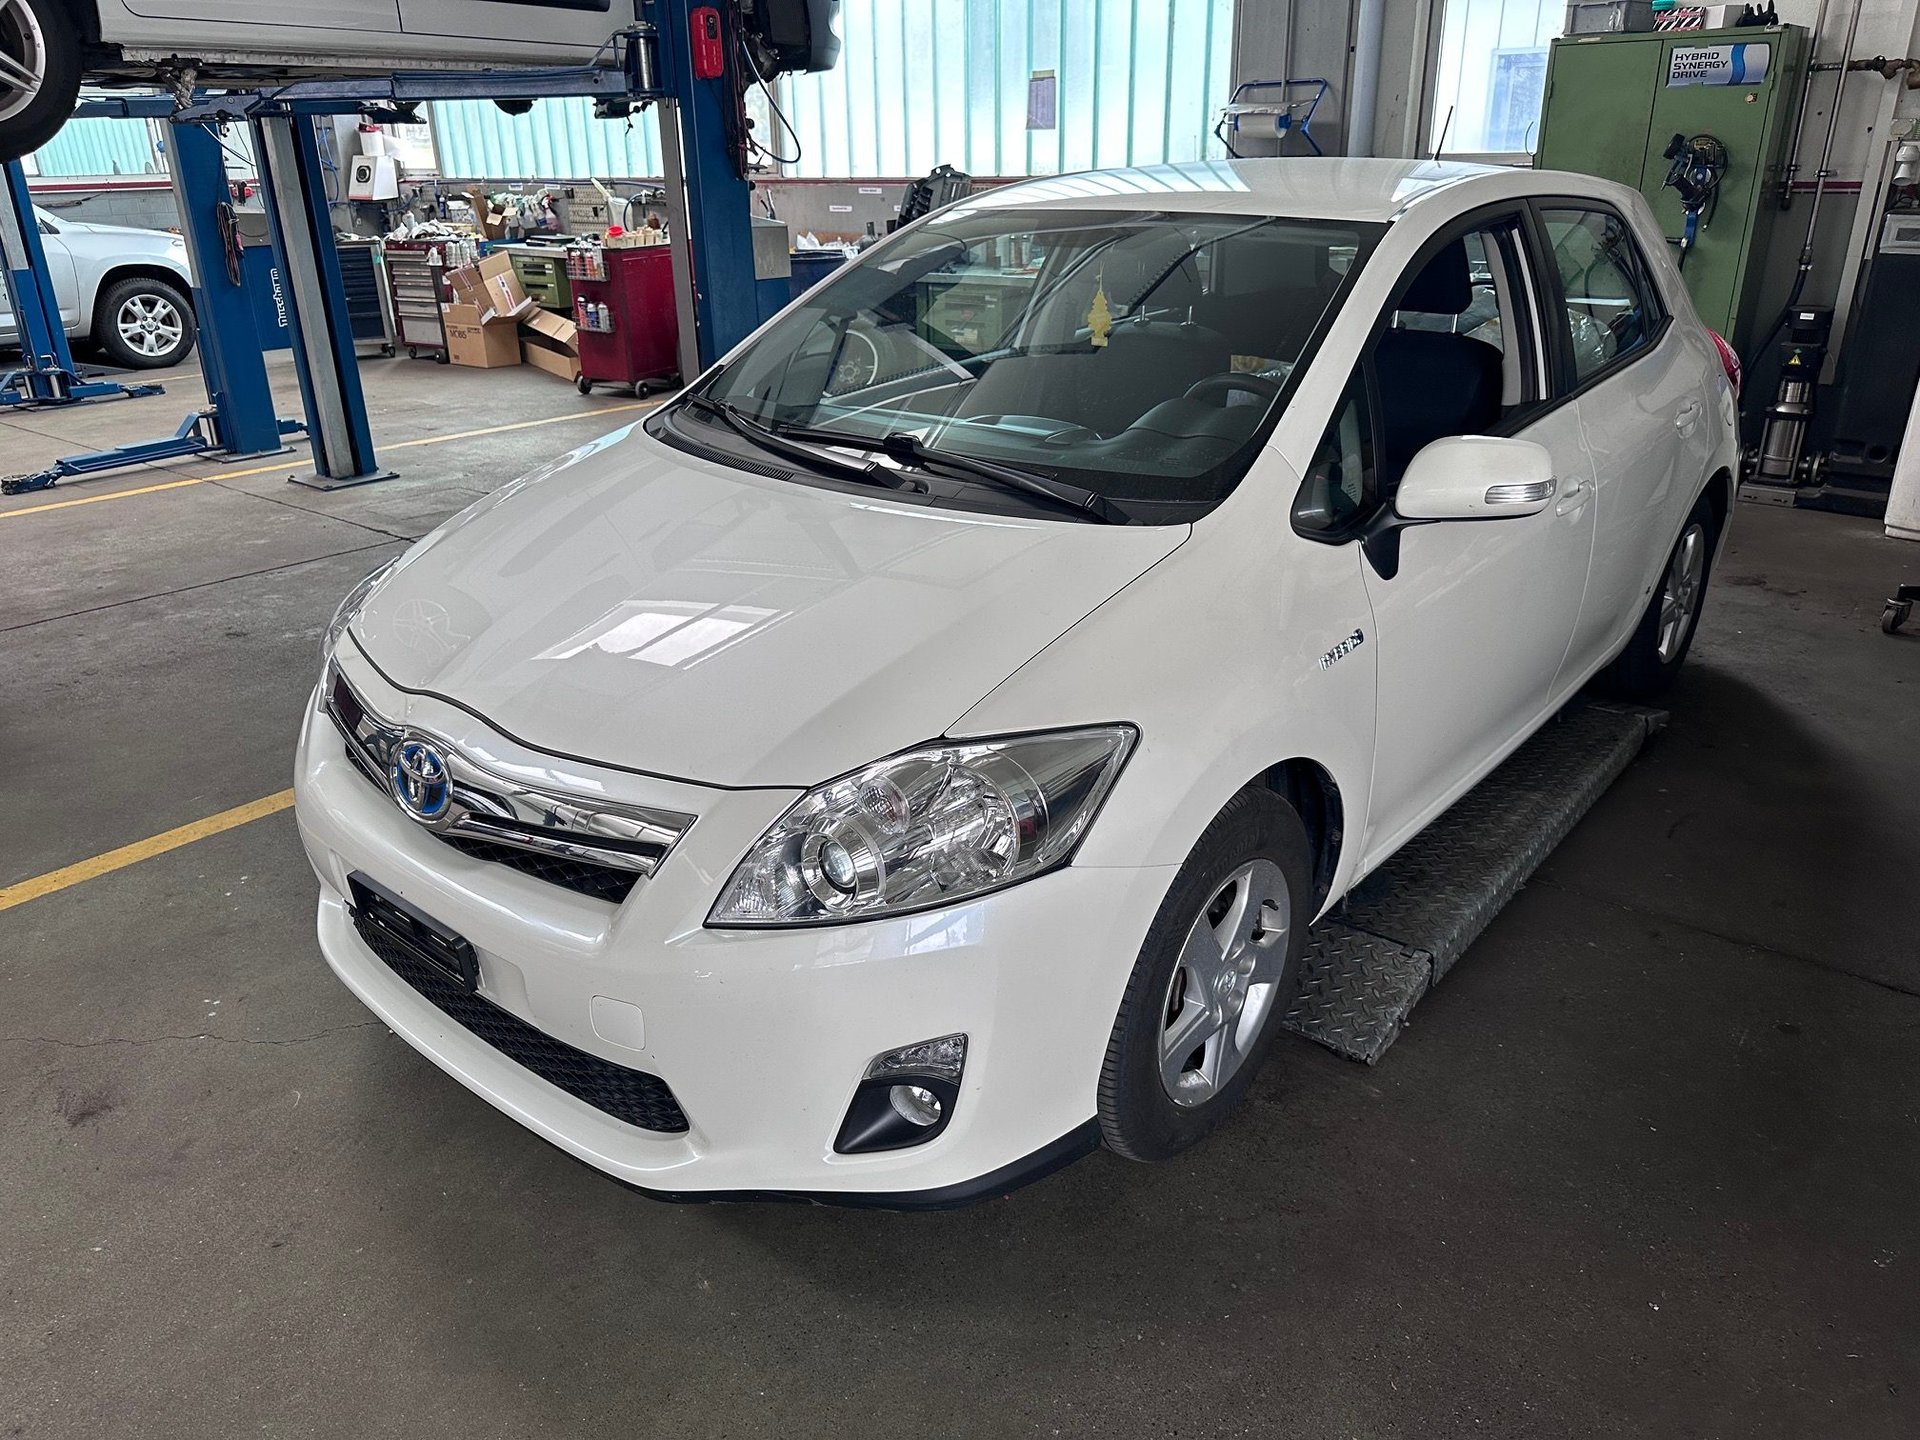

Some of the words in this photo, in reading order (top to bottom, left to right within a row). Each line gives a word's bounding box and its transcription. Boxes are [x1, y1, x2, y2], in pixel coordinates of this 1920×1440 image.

[1675, 52, 1720, 61] HYBRID
[1673, 60, 1728, 70] SYNERGY
[1672, 70, 1708, 79] DRIVE
